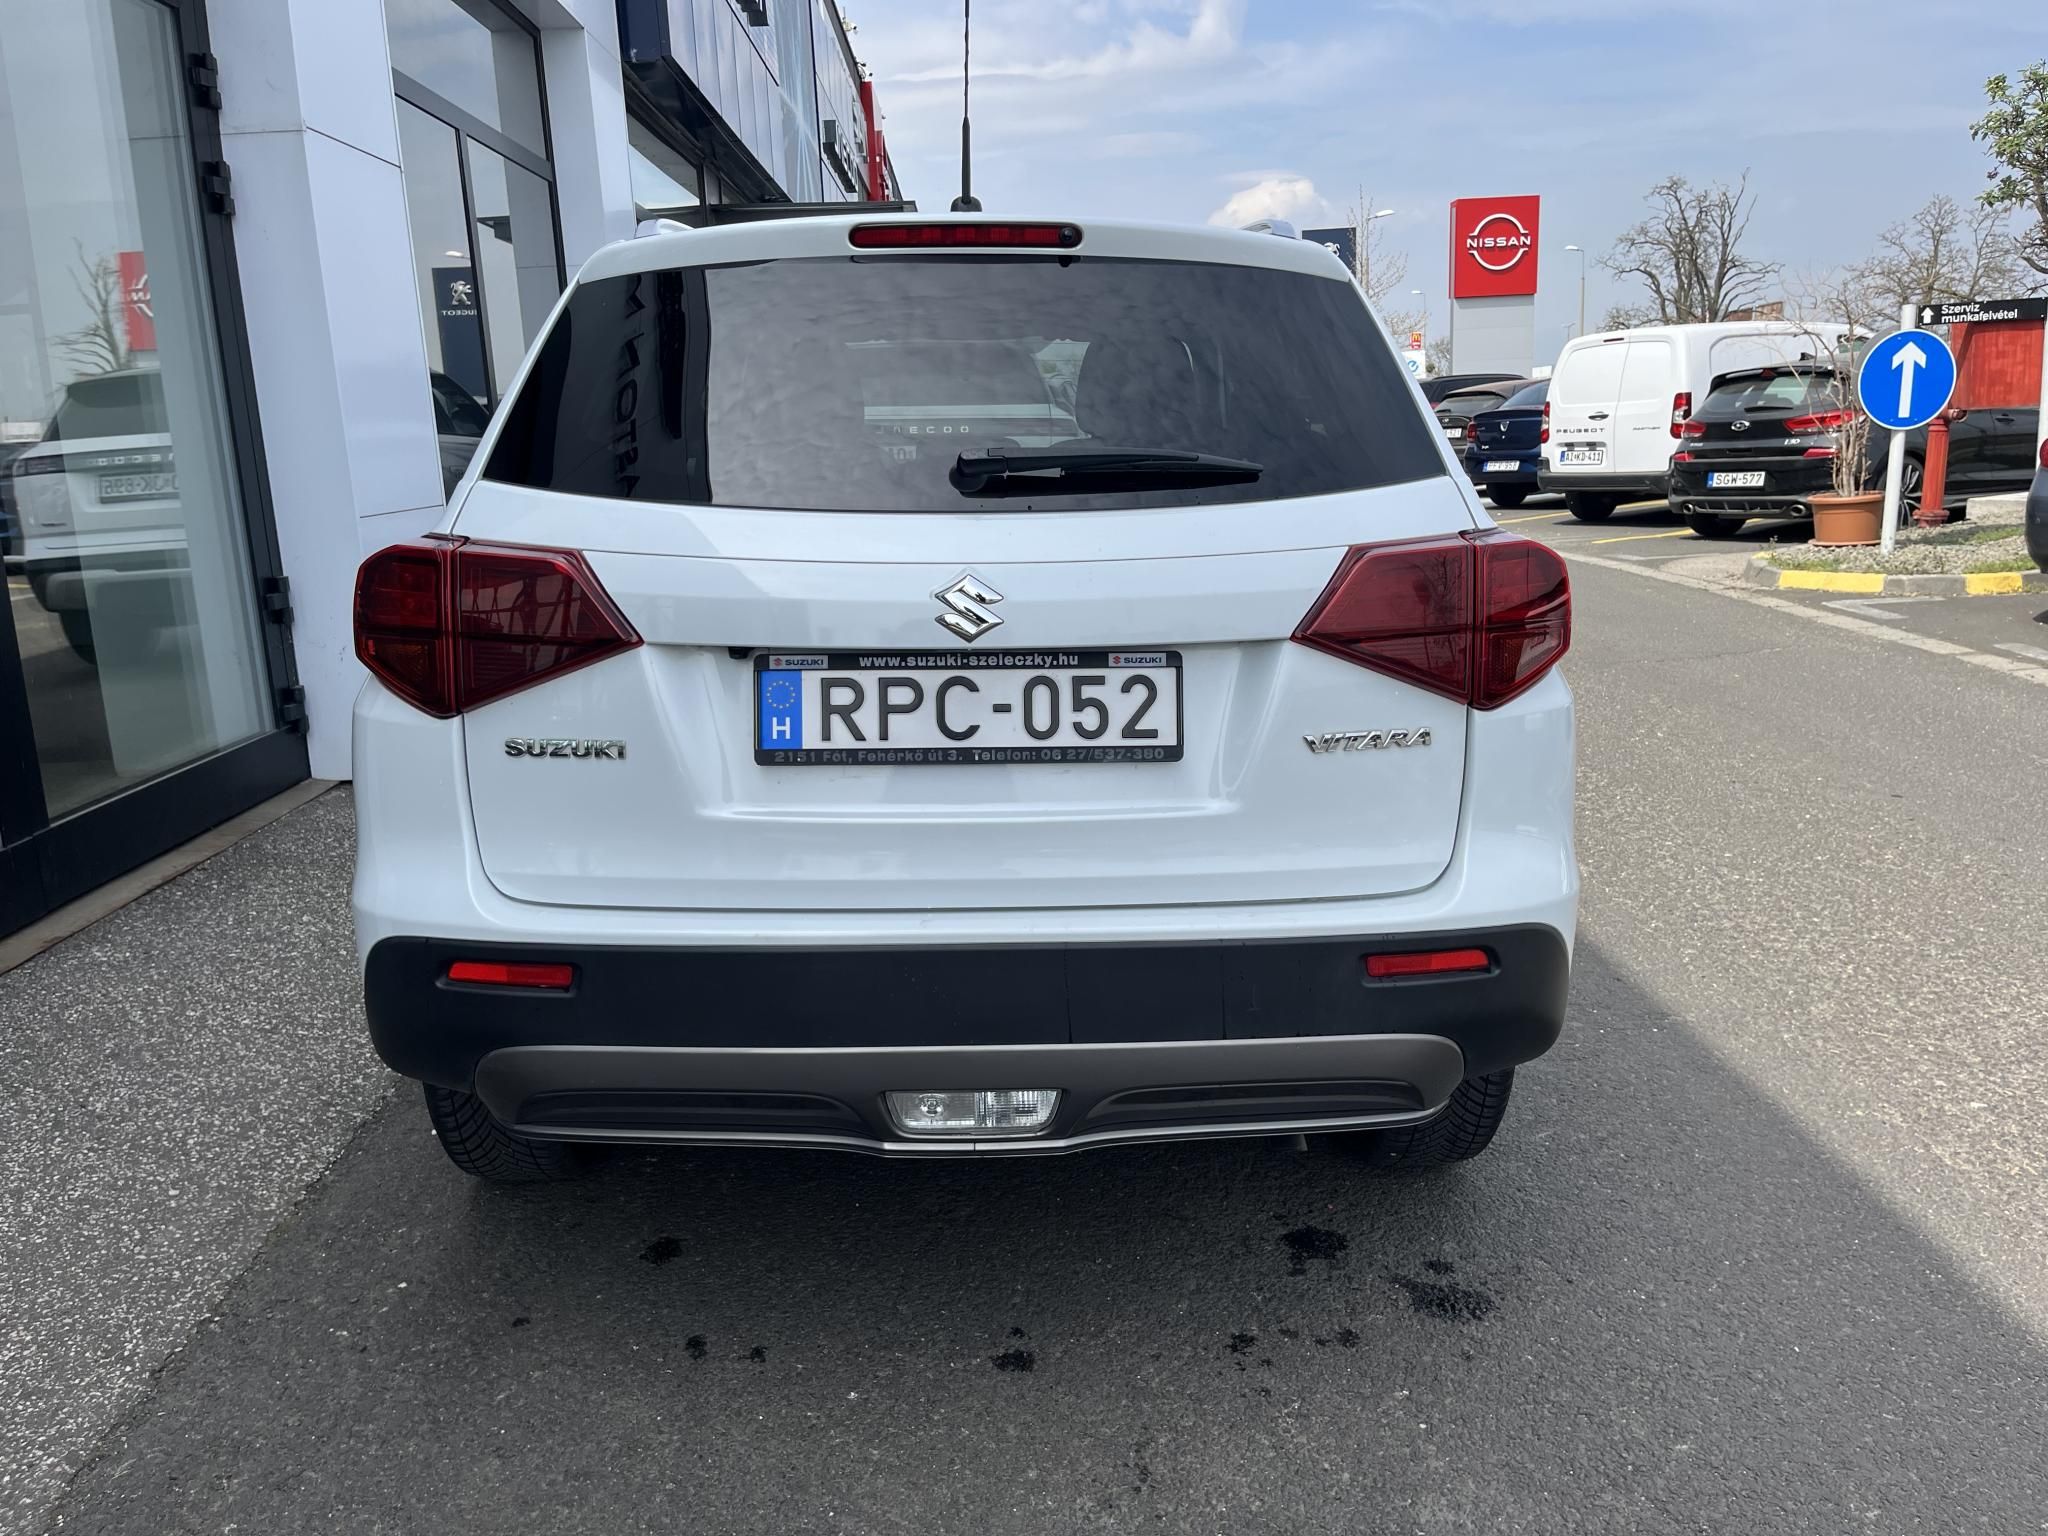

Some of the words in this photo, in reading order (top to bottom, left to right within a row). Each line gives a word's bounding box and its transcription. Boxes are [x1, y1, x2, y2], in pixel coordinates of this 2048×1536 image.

[1466, 236, 1531, 248] NISSAN
[1941, 303, 1980, 314] Szerviz
[1941, 309, 2018, 323] munkafelvétel
[1715, 473, 1763, 485] SGW-577
[859, 653, 1079, 668] www.suzuki-szeleczky.hu
[1123, 656, 1162, 664] SUZUKI
[820, 674, 1159, 742] RPC-052
[772, 716, 790, 740] H
[1303, 727, 1432, 753] VITARA
[504, 738, 627, 760] SUZUKI
[774, 751, 816, 762] 2151
[947, 750, 963, 761] 3.
[973, 750, 1036, 761] Telefon:
[1041, 749, 1061, 760] 06
[1066, 748, 1164, 761] 27/537-380
